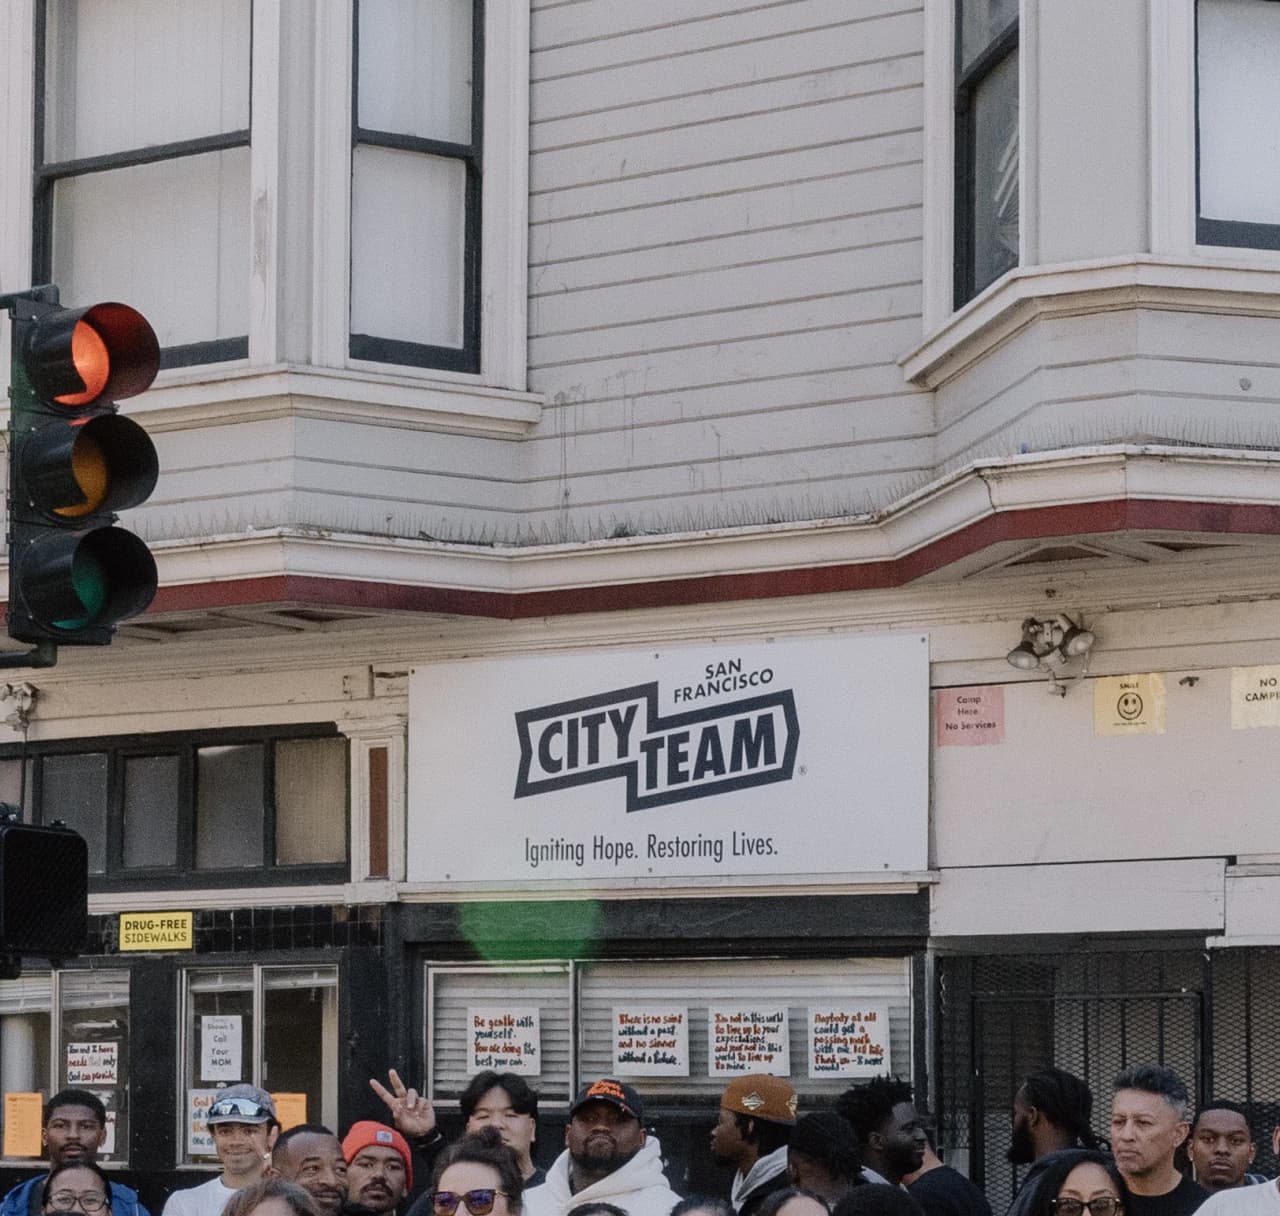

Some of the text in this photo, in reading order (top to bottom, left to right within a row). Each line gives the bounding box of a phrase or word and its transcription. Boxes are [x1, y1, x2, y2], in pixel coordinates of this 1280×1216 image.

[705, 657, 742, 680] SAN
[674, 667, 774, 704] FRANCISCO
[1260, 677, 1277, 687] NO
[956, 695, 981, 705] Camp
[958, 707, 978, 716] Here
[945, 720, 996, 731] No Services
[538, 704, 639, 774] CITY
[640, 712, 777, 791] TEAM
[525, 831, 778, 867] Igniting Hope. Restoring Lives.
[125, 919, 187, 930] DRUG-FREE
[125, 931, 187, 943] SIDEWALKS
[474, 1014, 534, 1030] Be gentle with
[619, 1013, 682, 1024] There is no saint
[730, 1012, 783, 1023] not in this world
[815, 1012, 876, 1025] Anybody at all
[475, 1028, 517, 1041] yourself.
[618, 1025, 648, 1036] without
[715, 1024, 780, 1036] to live up to your
[814, 1023, 839, 1034] could
[842, 1022, 855, 1036] get
[618, 1038, 676, 1049] and no sinner
[814, 1033, 870, 1047] passing mark
[99, 1045, 113, 1053] have
[474, 1042, 536, 1057] You are doing the
[768, 1043, 782, 1052] this
[814, 1045, 833, 1053] with
[103, 1055, 116, 1067] only
[475, 1054, 493, 1067] best
[494, 1058, 507, 1068] you
[618, 1051, 646, 1063] without
[715, 1052, 774, 1063] world to live up
[864, 1057, 883, 1065] never
[69, 1071, 80, 1081] God
[193, 1096, 207, 1107] God
